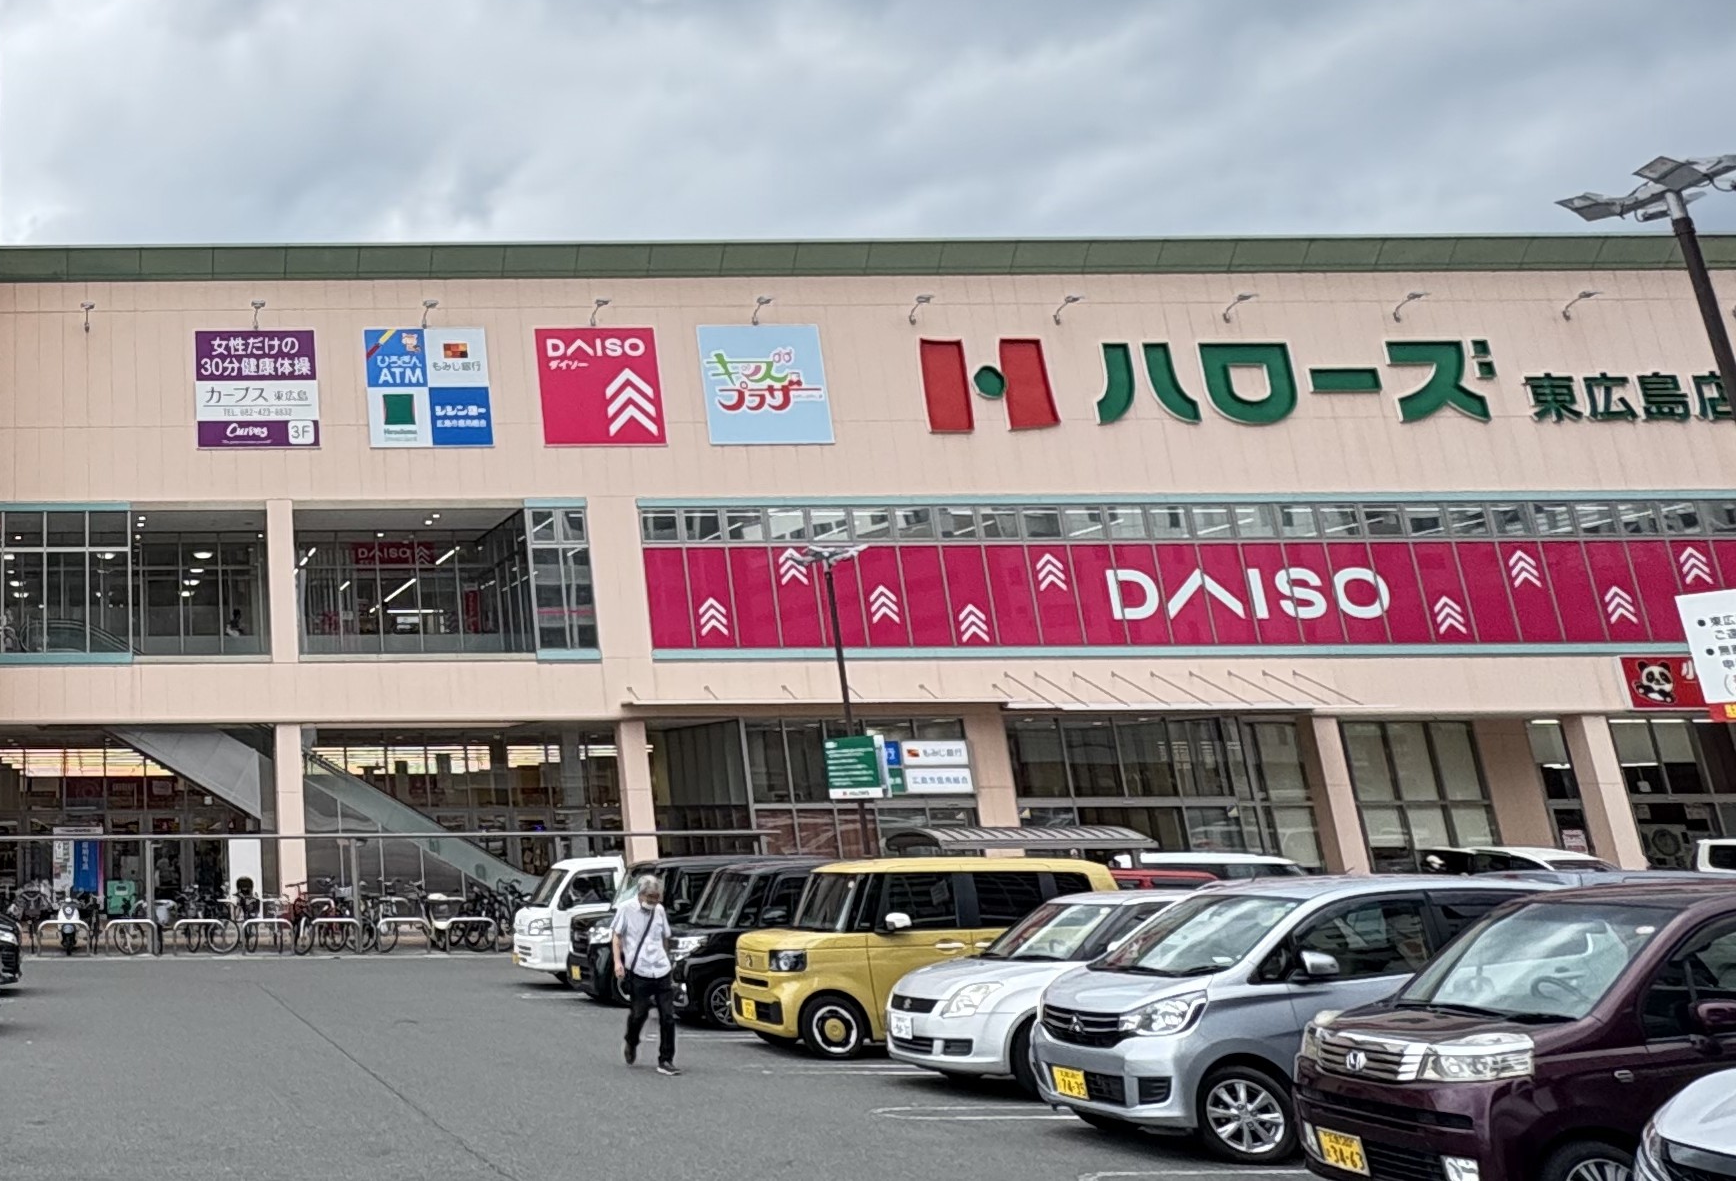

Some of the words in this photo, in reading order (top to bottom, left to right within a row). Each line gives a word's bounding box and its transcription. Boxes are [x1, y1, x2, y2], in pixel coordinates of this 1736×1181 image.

[210, 336, 299, 356] 女性だけの
[546, 338, 646, 357] DAISO
[200, 356, 312, 376] 30分健康体操
[376, 355, 423, 368] ひろぎん
[433, 361, 481, 372] もみじ銀行
[548, 359, 589, 370] ダイソー
[378, 368, 424, 384] ATM
[1095, 339, 1496, 426] ハローズ
[1523, 372, 1735, 424] 東広島店
[205, 386, 269, 404] カーブス
[273, 390, 309, 402] 東広島
[717, 380, 821, 411] プラザ
[226, 422, 269, 437] Curves
[291, 425, 312, 439] 3F
[1105, 567, 1391, 620] DAISO
